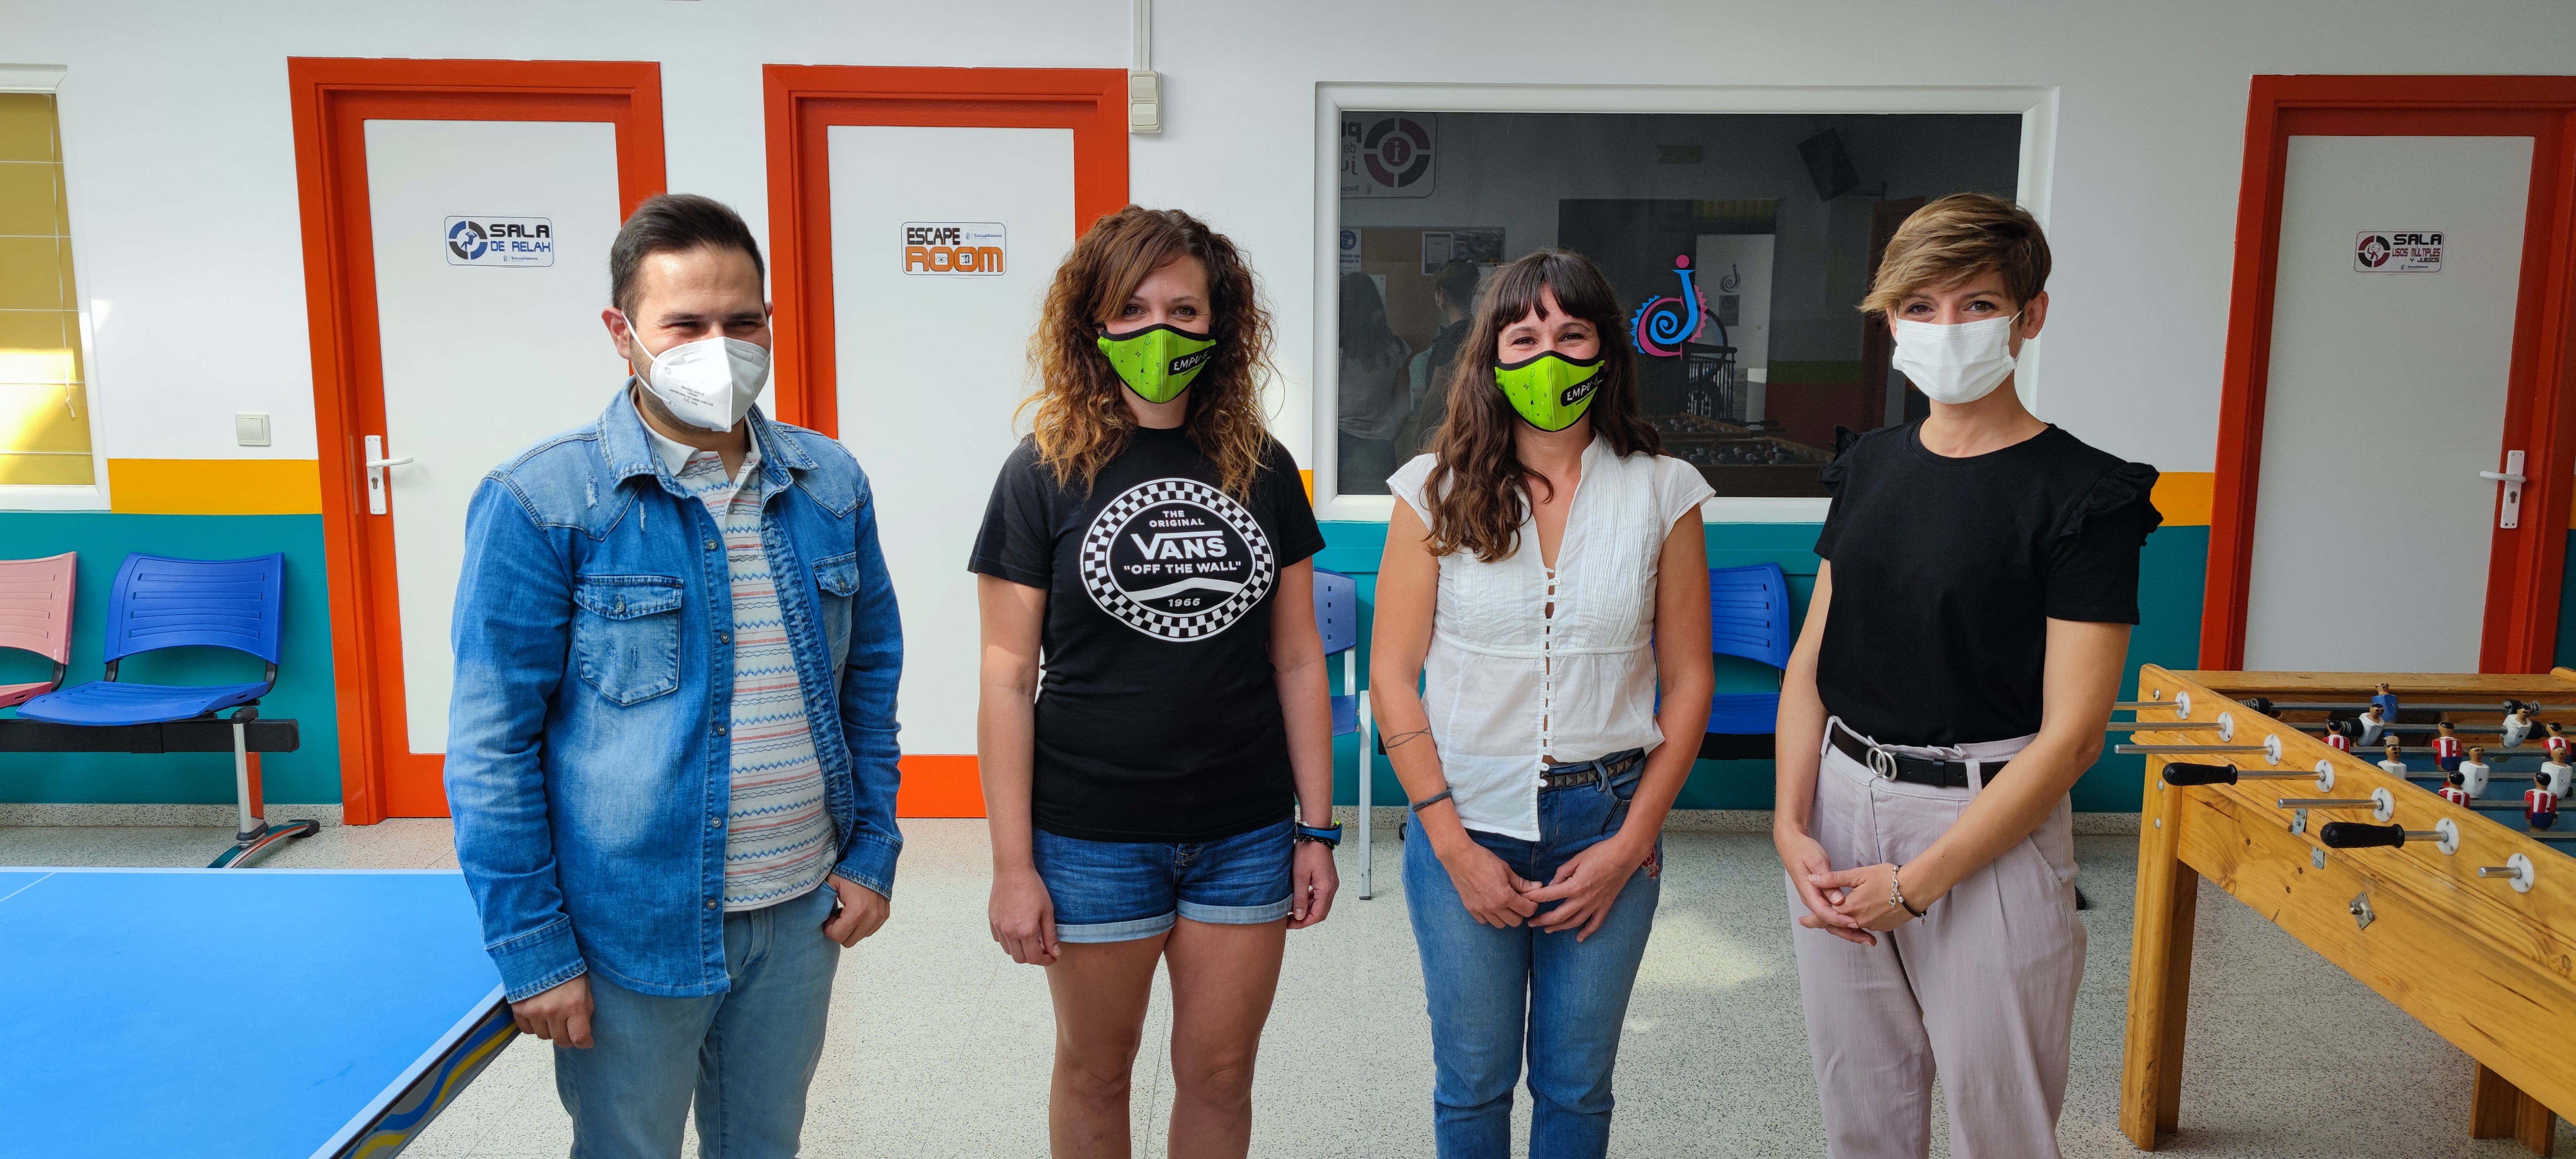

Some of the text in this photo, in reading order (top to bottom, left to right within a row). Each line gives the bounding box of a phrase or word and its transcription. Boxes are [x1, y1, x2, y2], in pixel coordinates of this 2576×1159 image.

[490, 224, 550, 238] SALA
[907, 228, 960, 245] ESCAPE
[2393, 234, 2442, 245] SALA
[490, 241, 505, 251] DE
[2392, 246, 2440, 257] USOS MÚLTIPLES
[906, 246, 1003, 272] ROOM
[1149, 518, 1204, 527] ORIGINAL
[1130, 530, 1227, 560] VANS
[1165, 564, 1193, 573] THE
[1168, 598, 1201, 607] 1966
